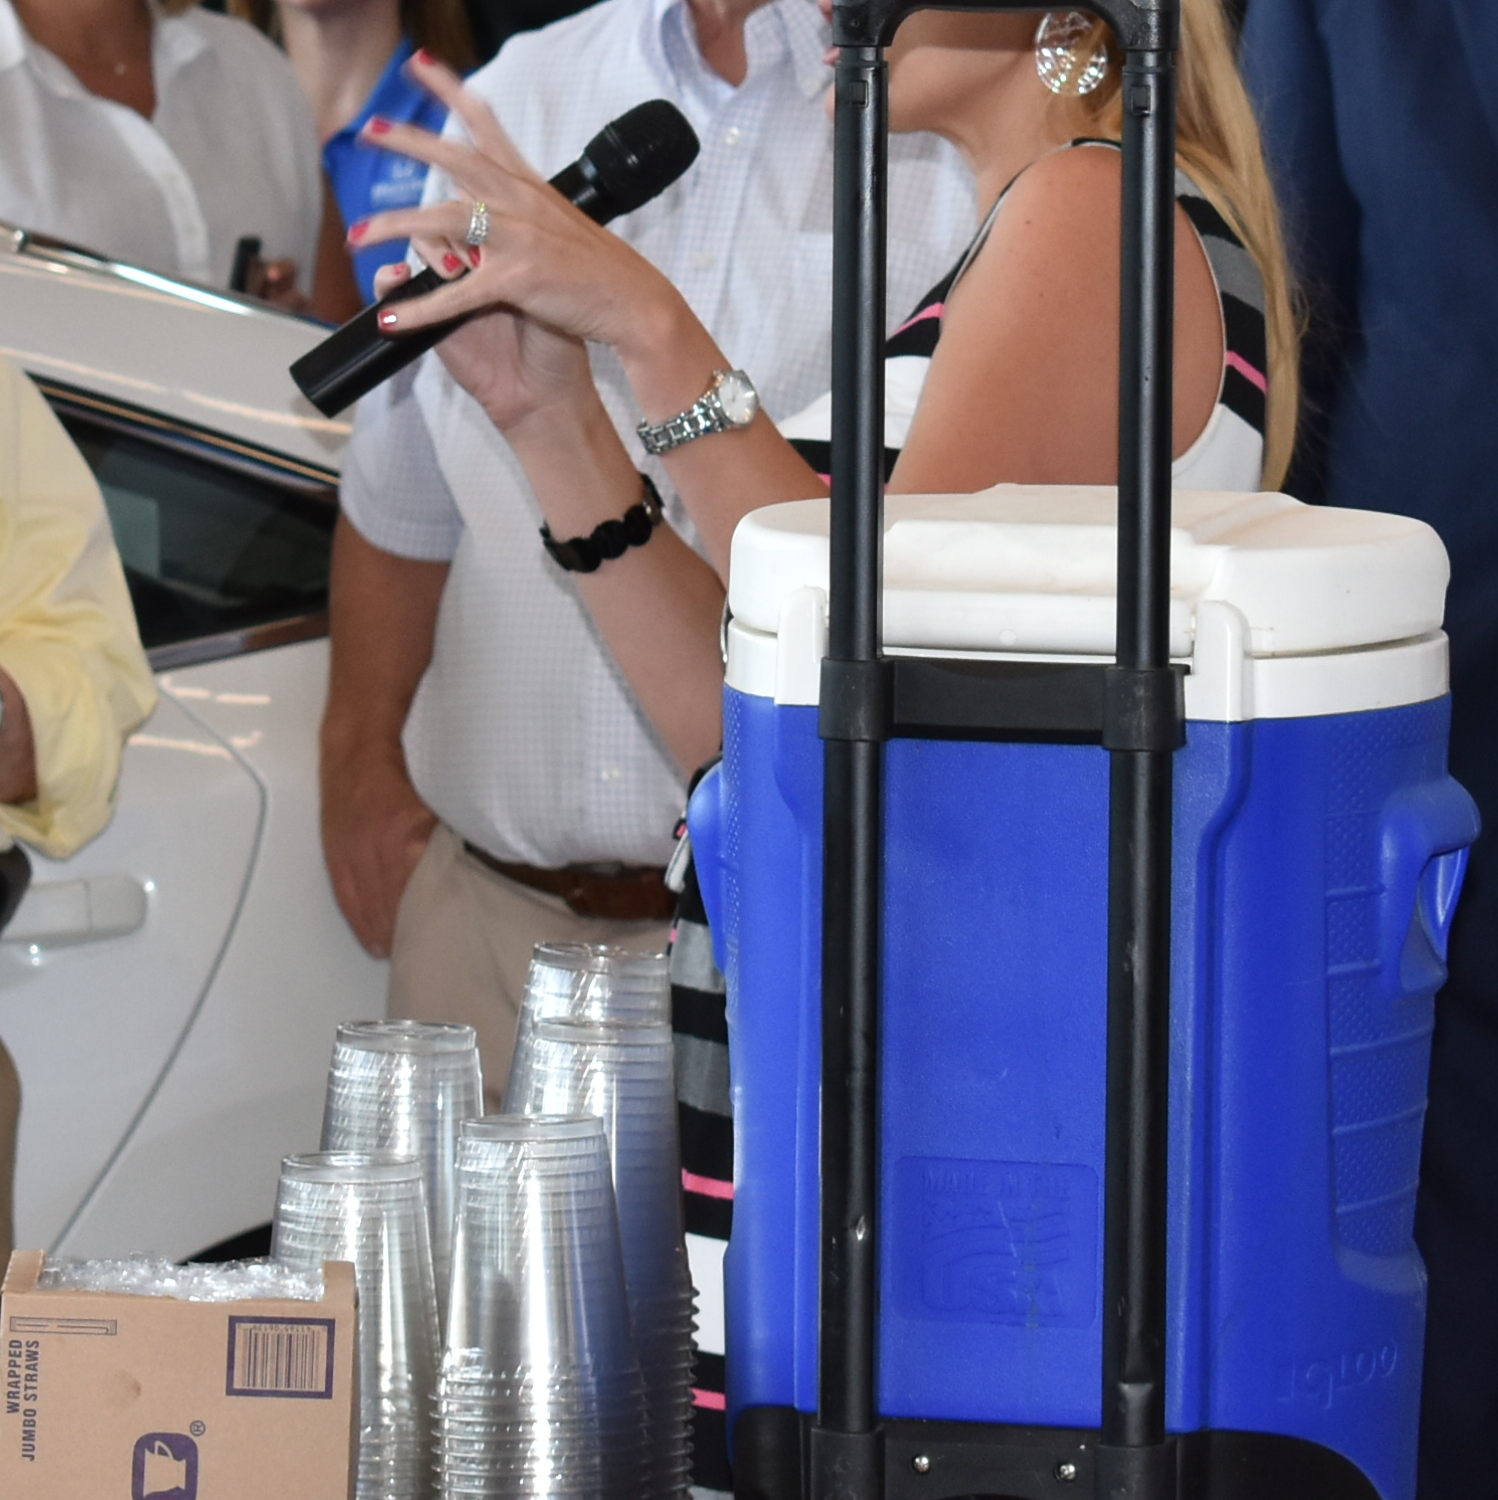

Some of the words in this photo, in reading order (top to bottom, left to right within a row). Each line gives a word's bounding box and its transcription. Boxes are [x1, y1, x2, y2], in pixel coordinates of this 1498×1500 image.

[6, 1339, 22, 1414] WRAPPED
[23, 1339, 40, 1402] STRAWS
[21, 1408, 37, 1462] JUMBO
